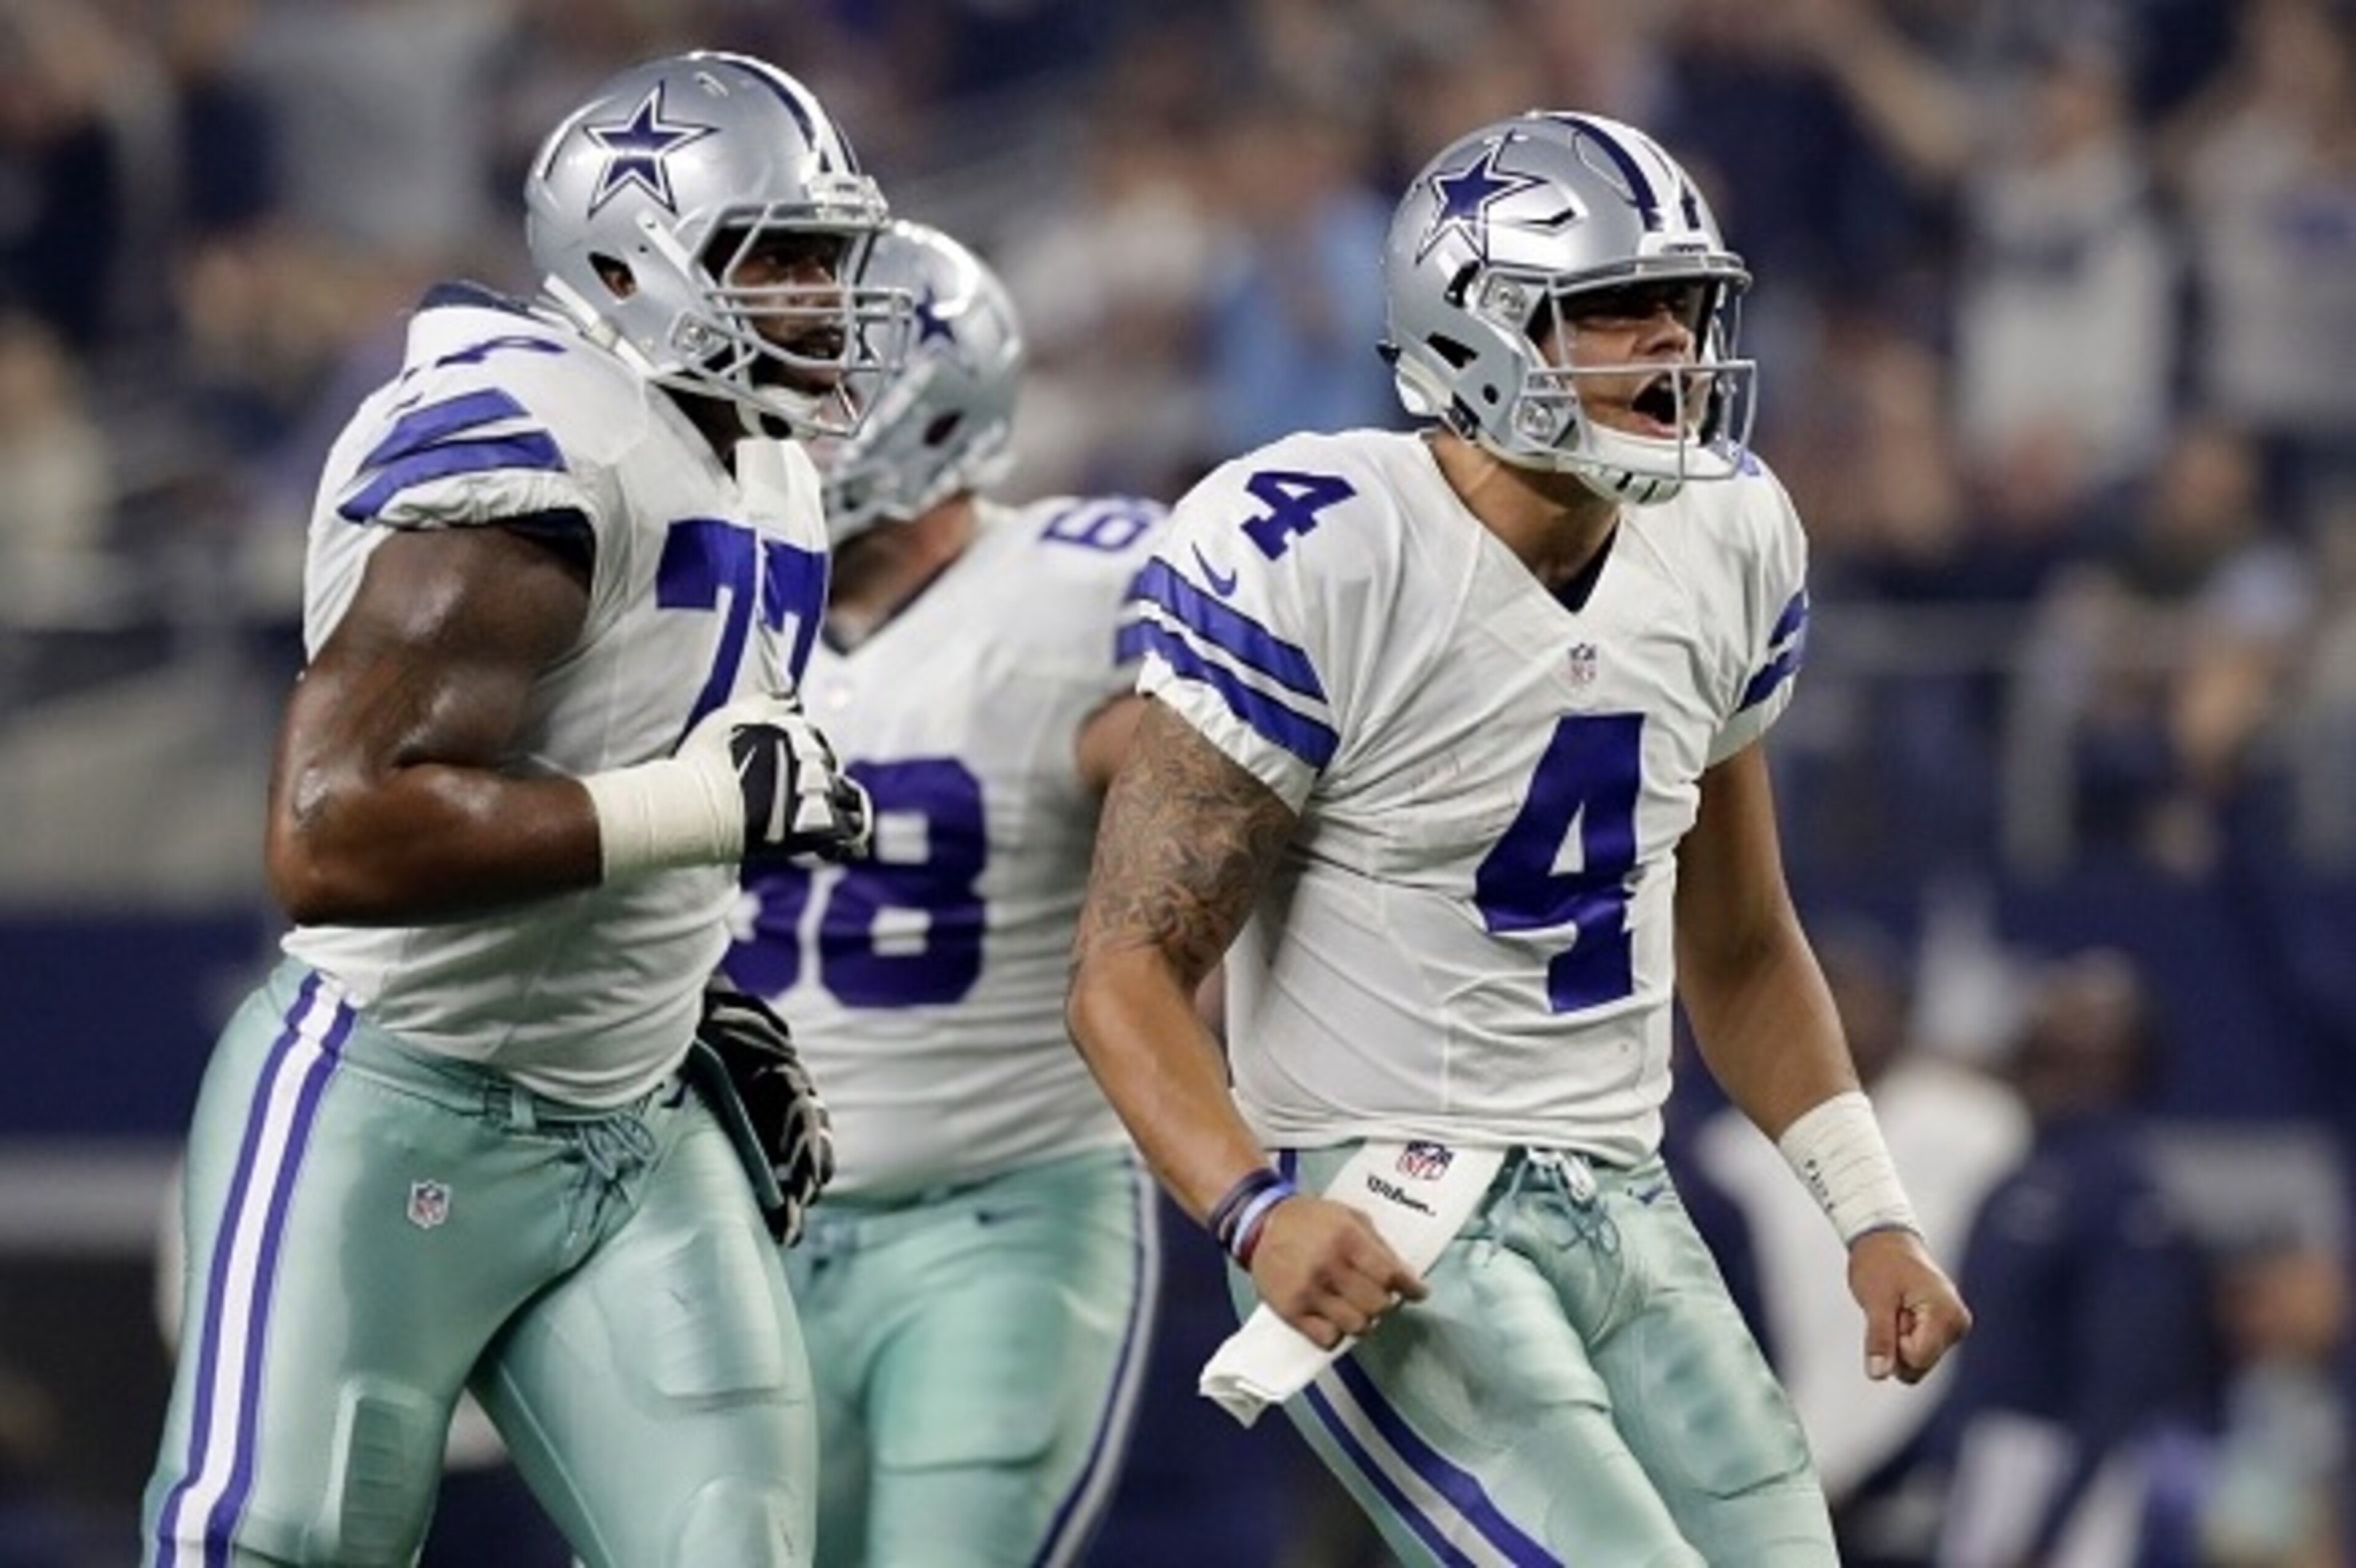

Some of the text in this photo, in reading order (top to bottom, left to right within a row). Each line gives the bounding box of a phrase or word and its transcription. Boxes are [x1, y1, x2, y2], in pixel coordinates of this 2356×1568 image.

[1239, 471, 1357, 561] 4
[656, 518, 826, 759] 77
[1475, 712, 1646, 1013] 4
